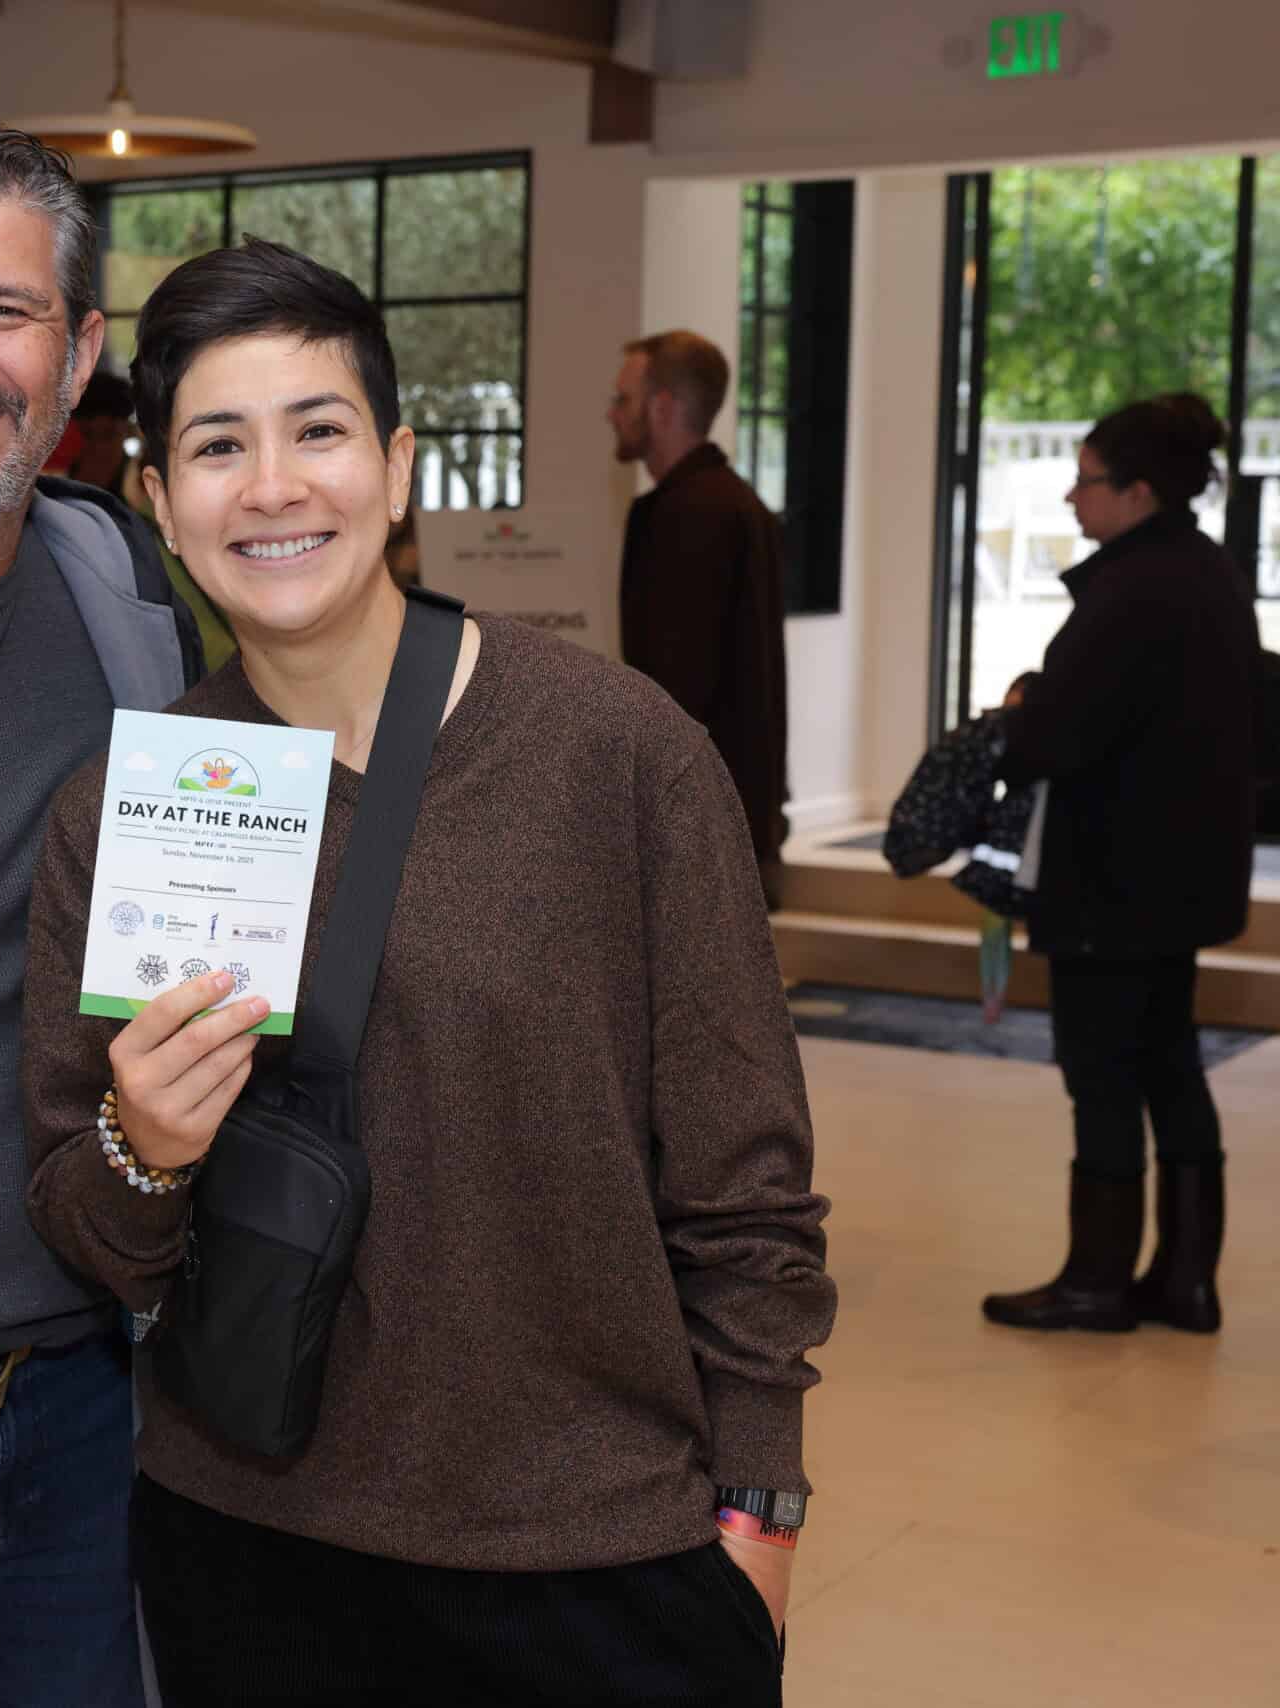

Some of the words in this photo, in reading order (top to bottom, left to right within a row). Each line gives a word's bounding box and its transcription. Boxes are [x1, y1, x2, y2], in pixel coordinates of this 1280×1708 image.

[987, 12, 1067, 79] EXIT
[118, 800, 159, 818] DAY
[162, 805, 188, 822] AT
[193, 808, 232, 826] THE
[238, 813, 307, 833] RANCH
[169, 880, 205, 892] Presenting
[206, 884, 237, 894] Sponsors
